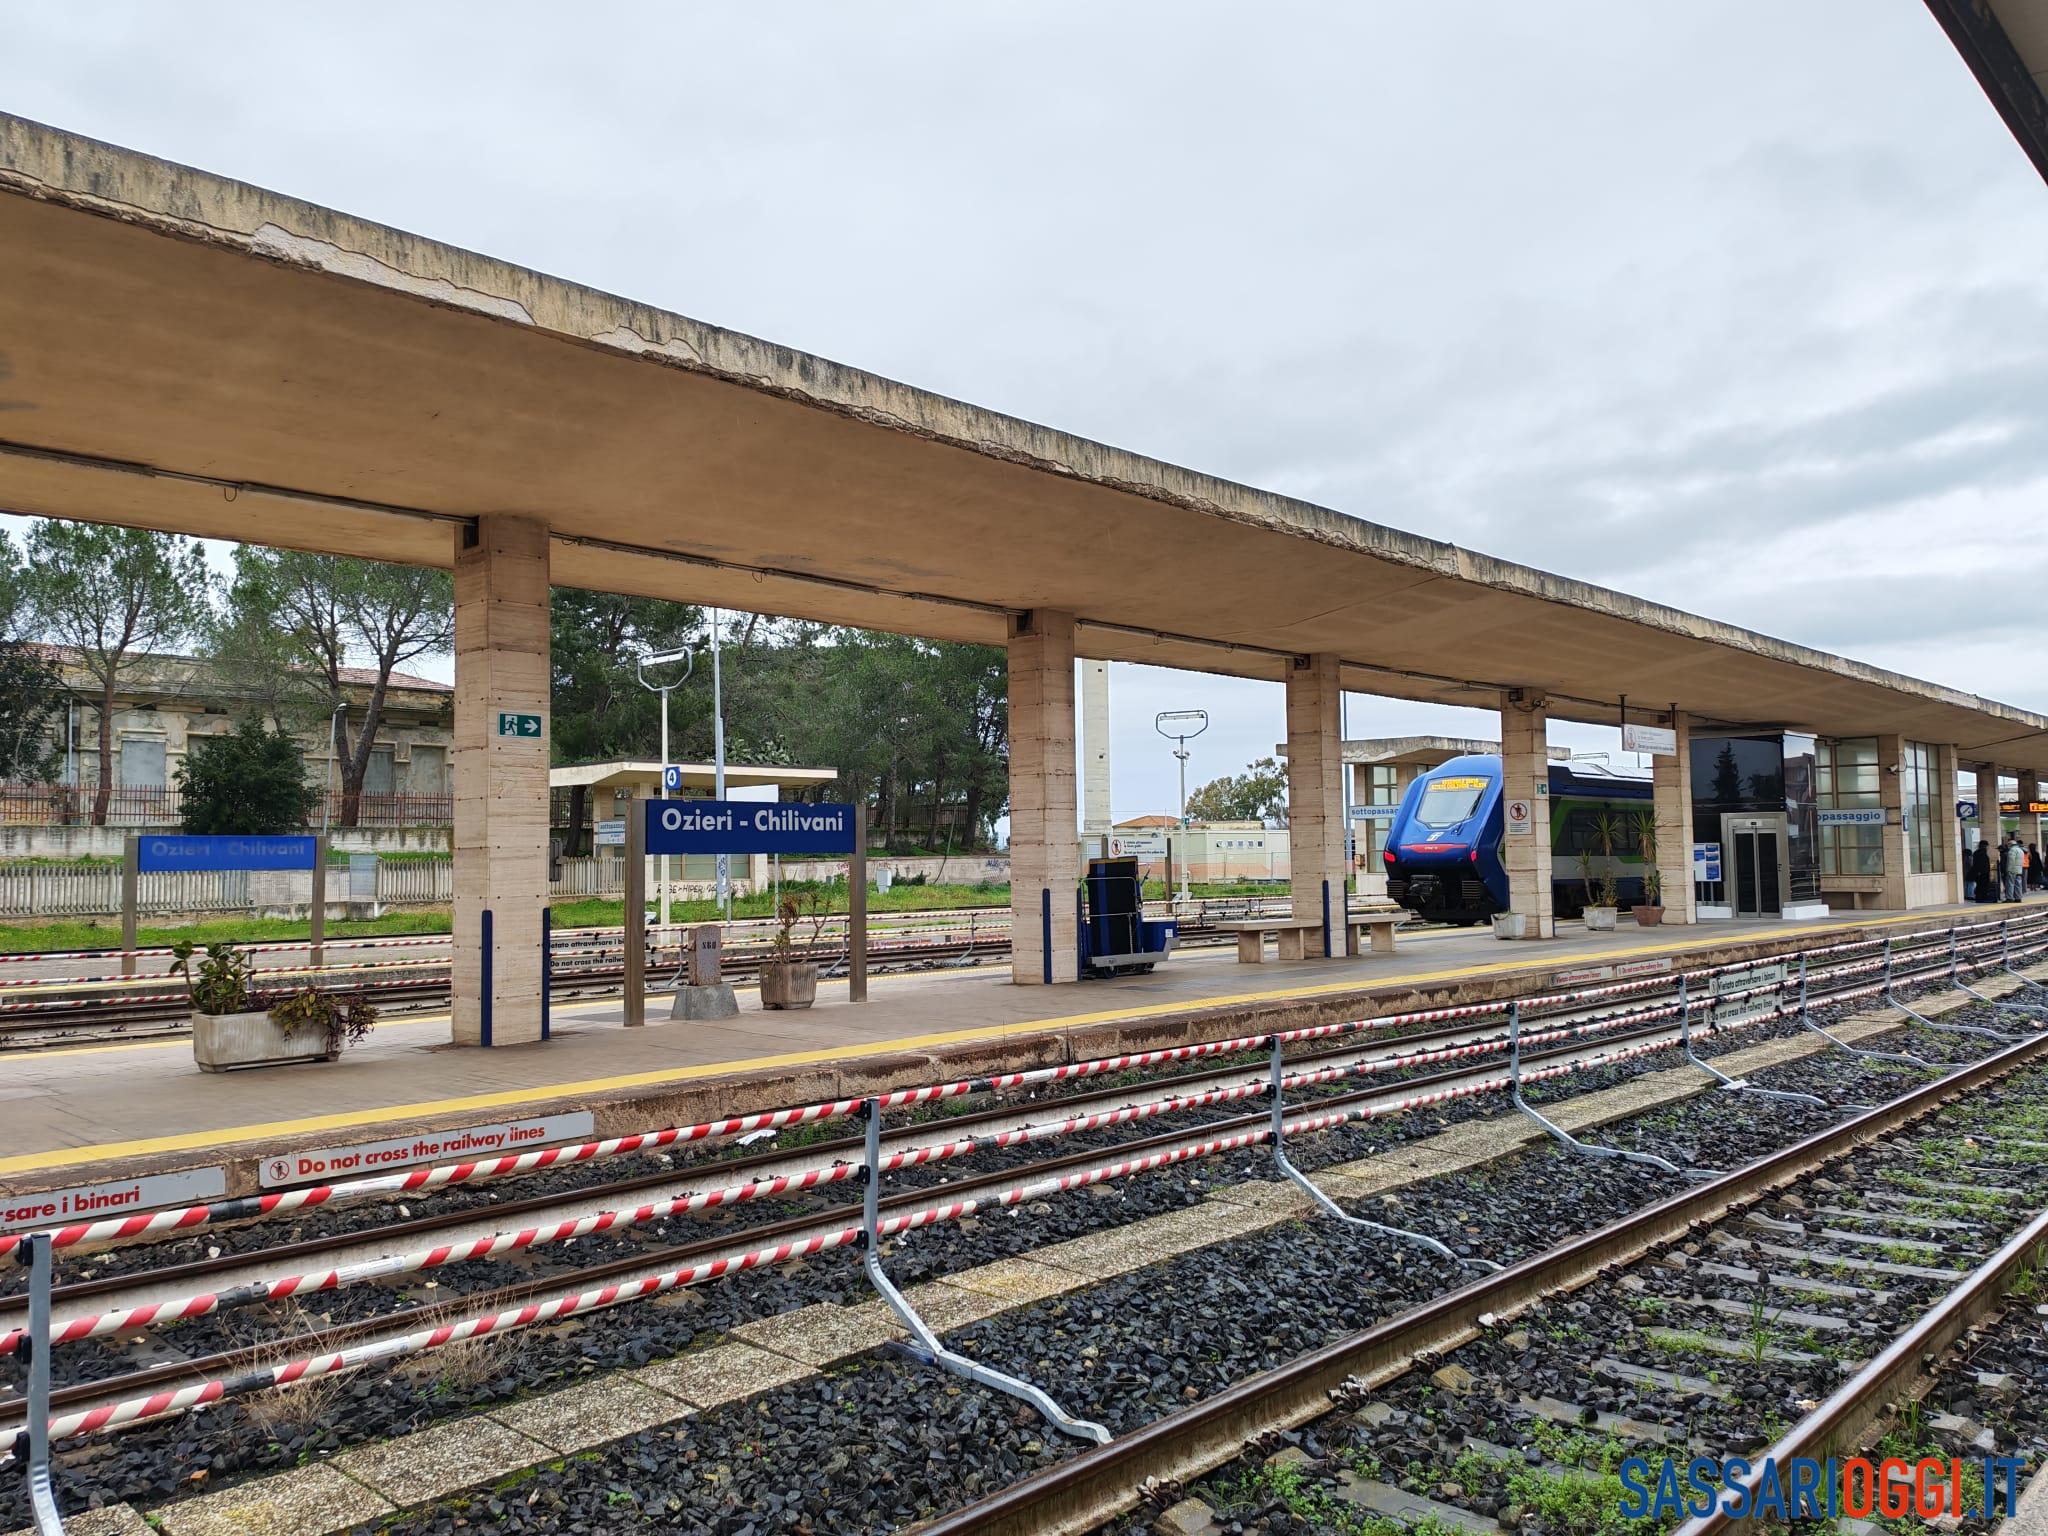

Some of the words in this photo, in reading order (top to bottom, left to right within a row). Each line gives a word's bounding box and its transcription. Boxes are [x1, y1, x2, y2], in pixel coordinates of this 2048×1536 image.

[669, 771, 675, 783] 4
[661, 808, 733, 831] Ozieri
[754, 809, 843, 831] Chilivani
[151, 841, 210, 856] Ozieri
[228, 841, 305, 856] Chilivani
[571, 940, 613, 948] attraversare
[298, 1158, 326, 1176] Do
[330, 1153, 360, 1171] not
[365, 1148, 409, 1164] cross
[413, 1141, 439, 1158] the
[443, 1132, 506, 1154] railway
[509, 1126, 545, 1142] lines
[61, 1196, 68, 1214] i
[74, 1185, 141, 1213] binari
